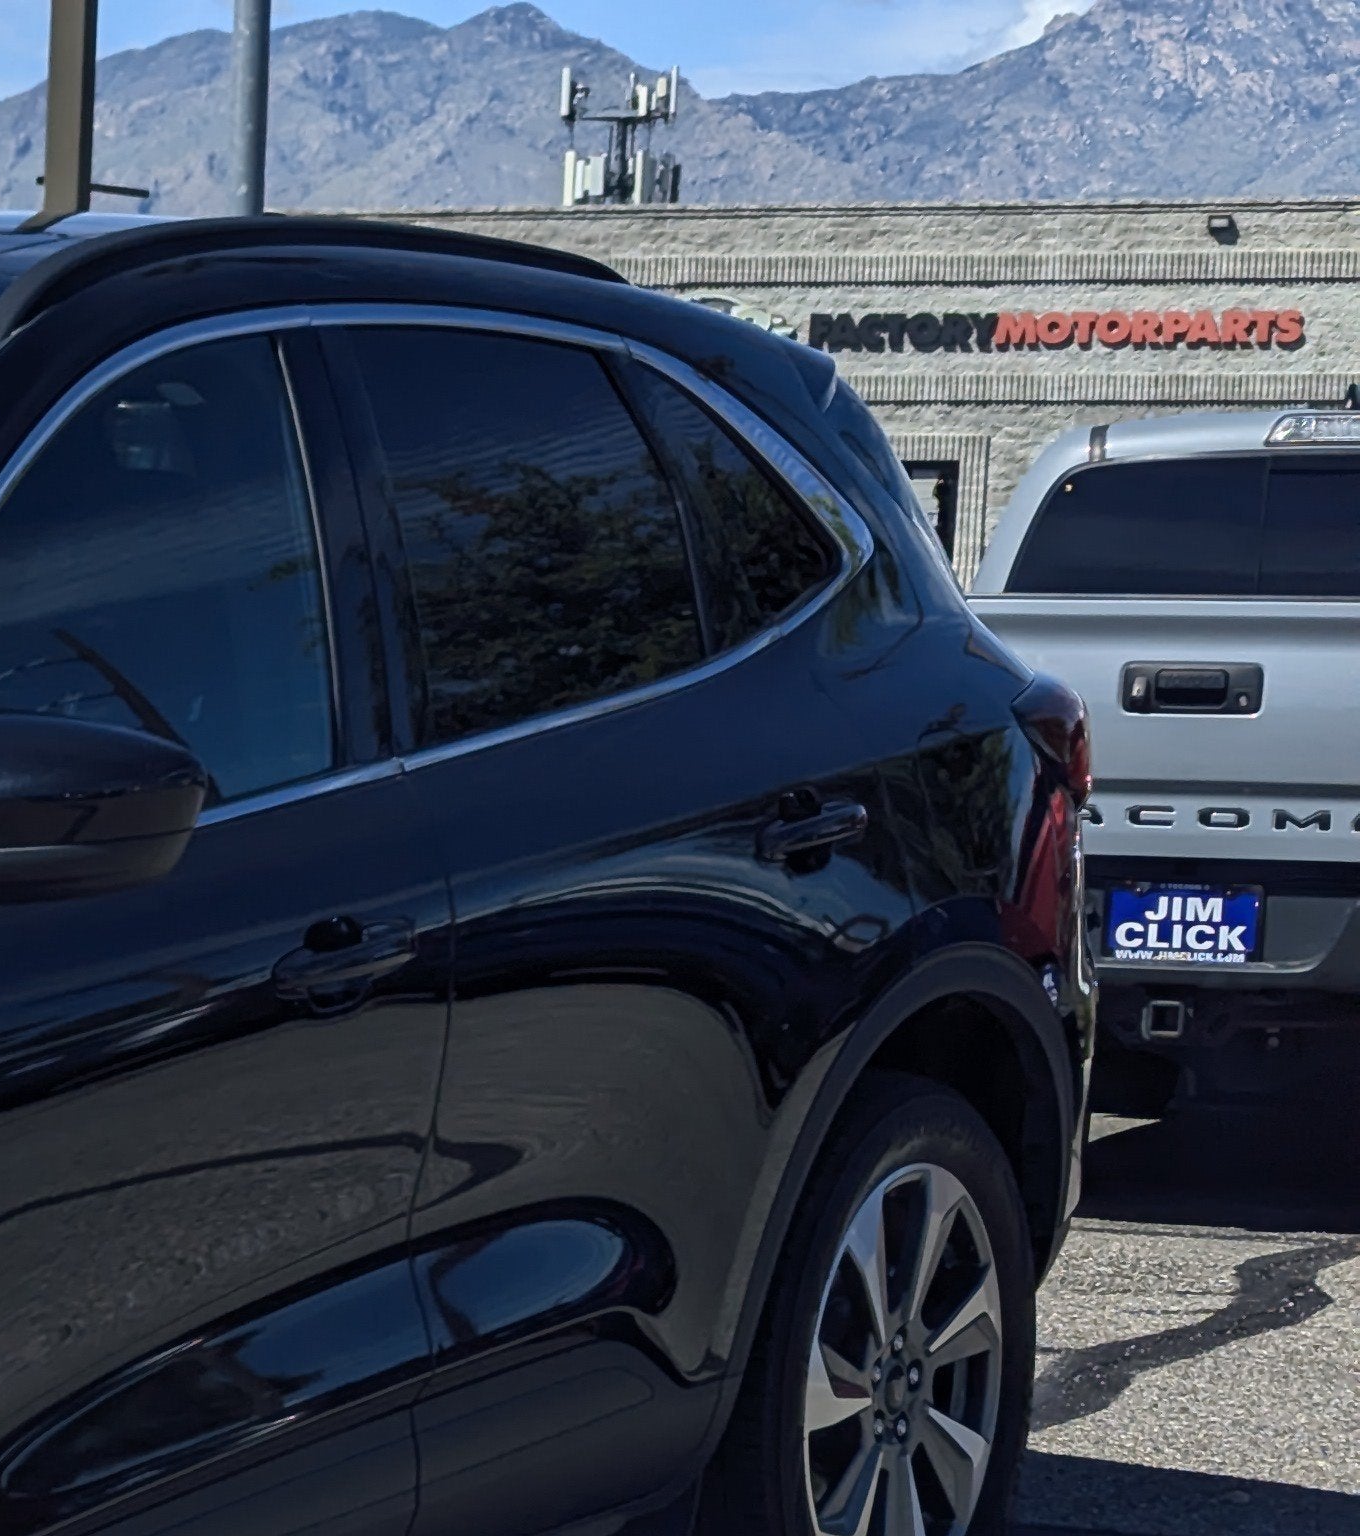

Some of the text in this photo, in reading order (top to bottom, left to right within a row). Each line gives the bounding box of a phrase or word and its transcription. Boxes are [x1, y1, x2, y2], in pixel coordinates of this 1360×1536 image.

[809, 312, 996, 353] FACTORY
[1078, 804, 1360, 833] ACOM
[1145, 896, 1223, 922] JIM
[1115, 922, 1247, 951] CLICK
